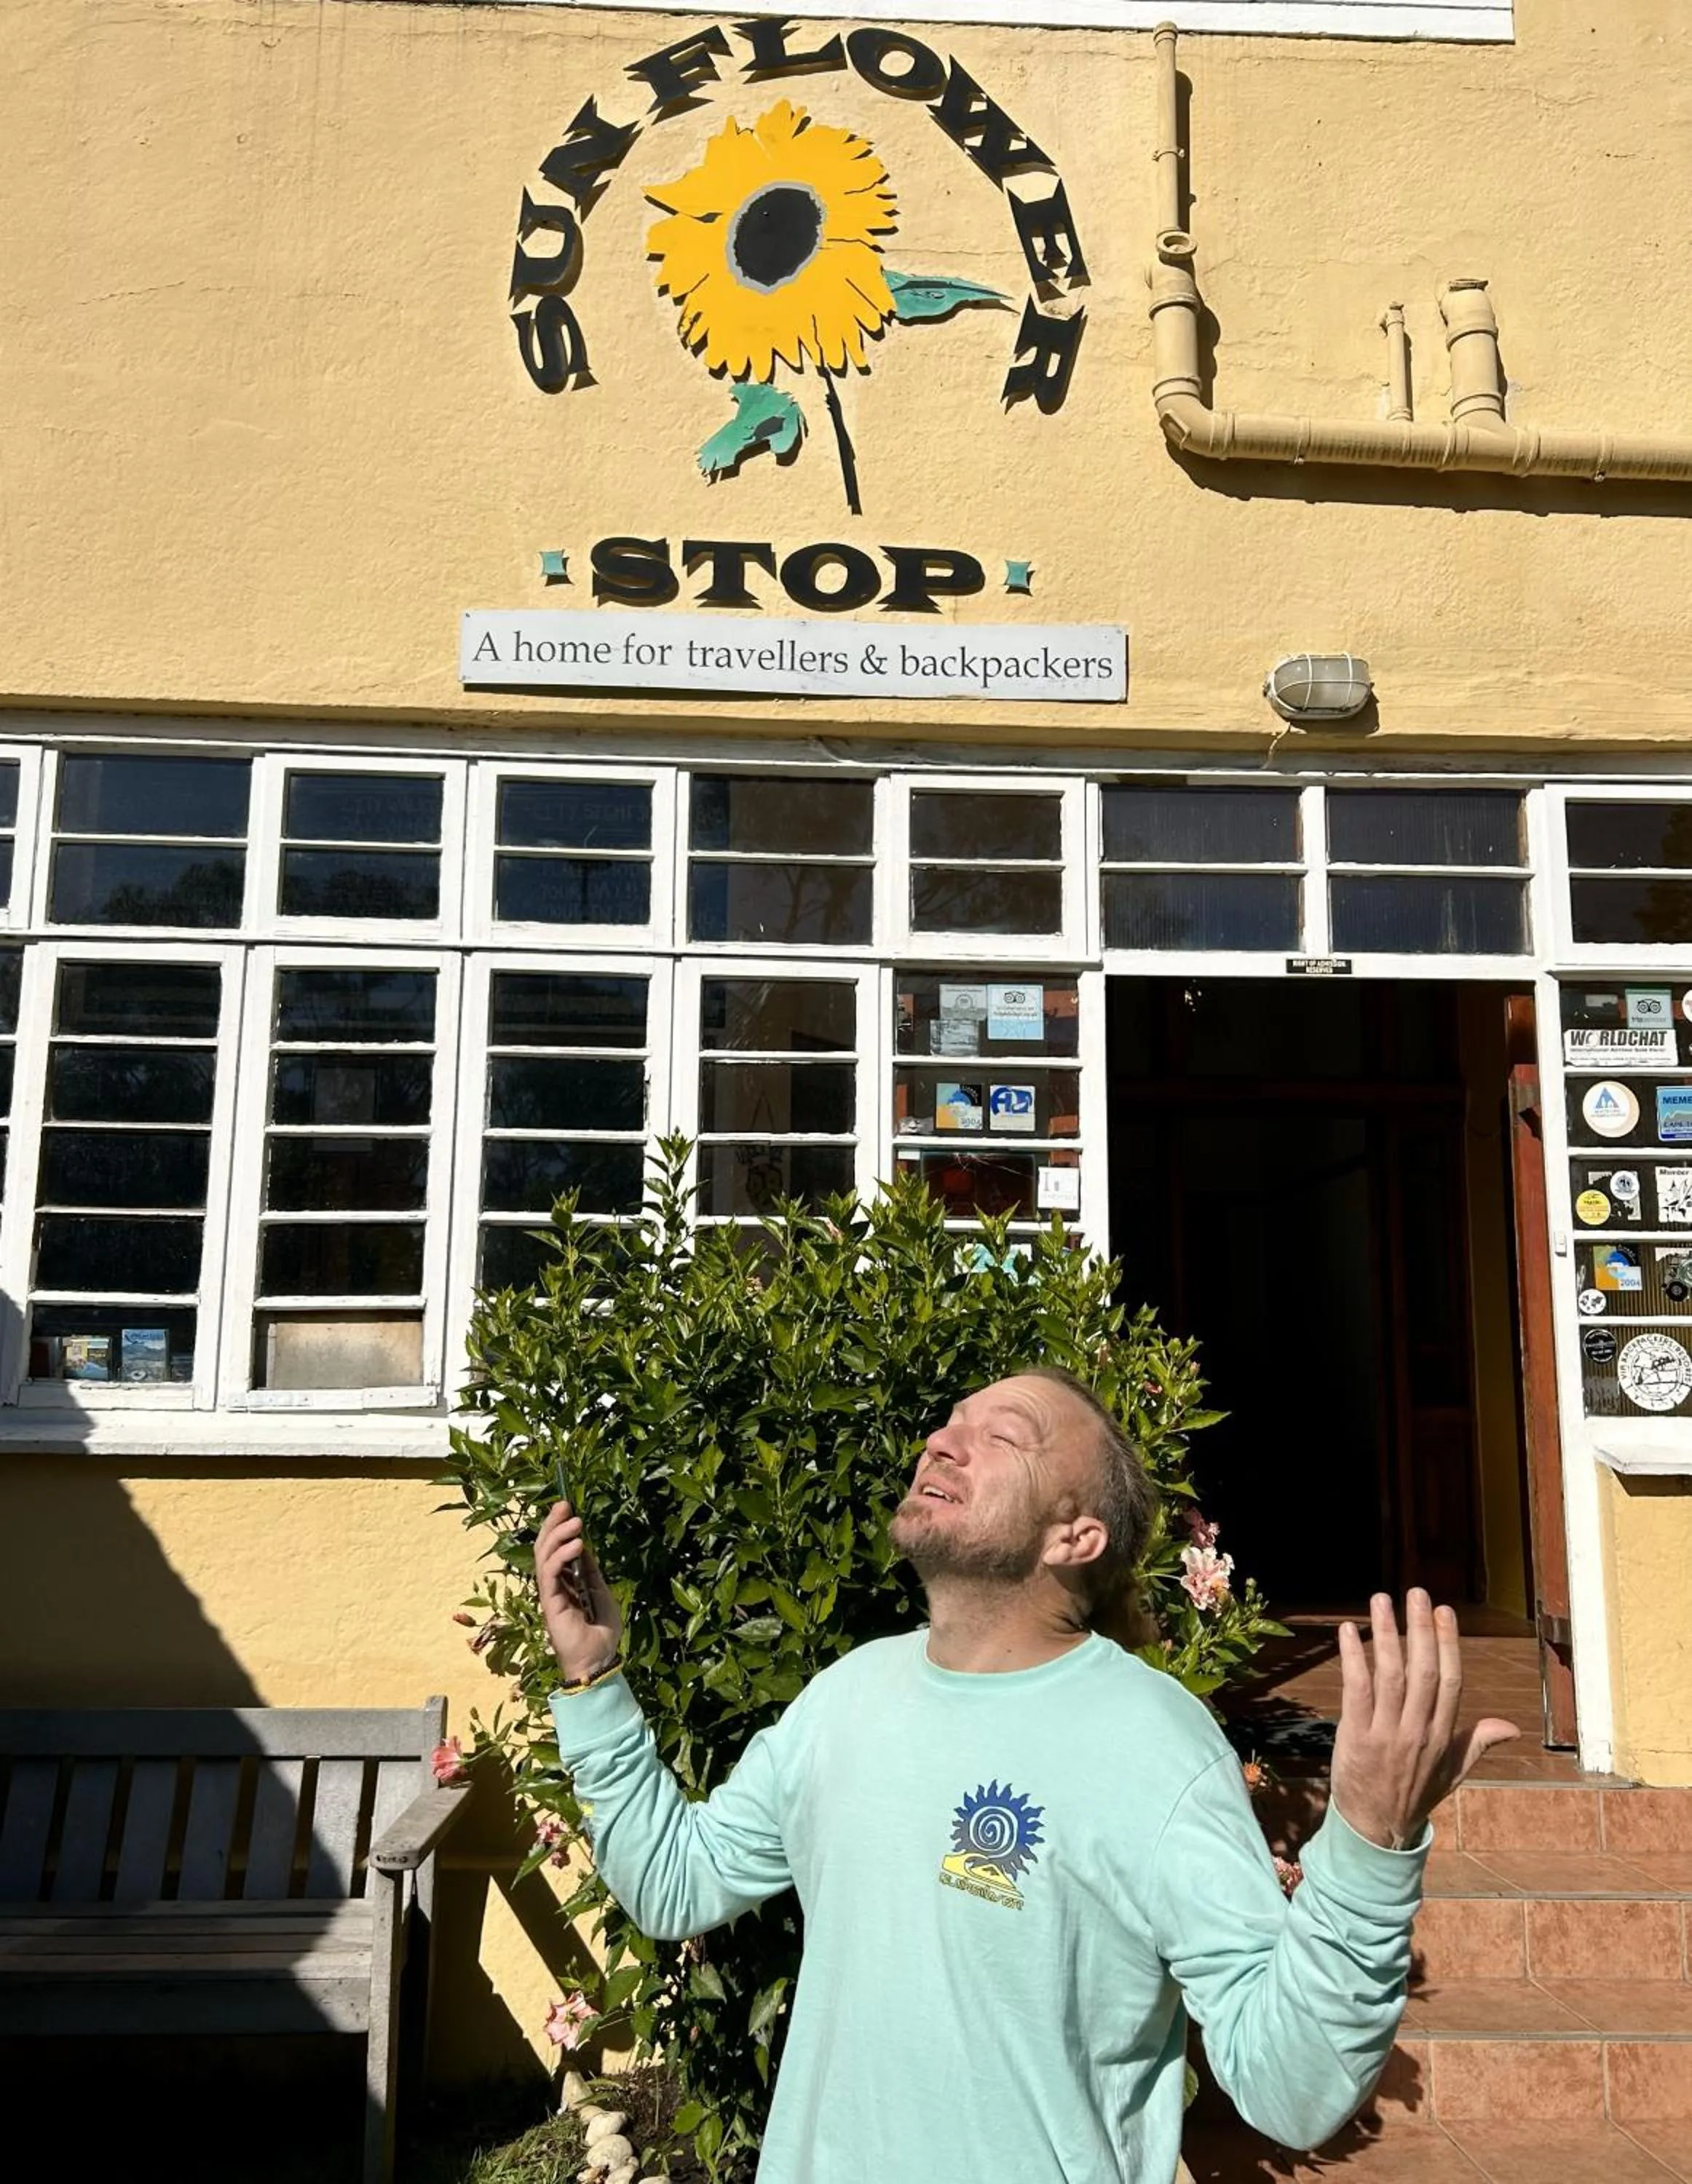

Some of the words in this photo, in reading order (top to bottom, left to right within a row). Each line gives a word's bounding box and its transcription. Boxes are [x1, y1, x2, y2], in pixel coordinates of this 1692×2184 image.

[508, 17, 1091, 415] SUNFLOWER
[590, 537, 986, 614] STOP
[472, 631, 502, 662] A
[512, 630, 612, 664] home
[621, 633, 673, 665] for
[687, 639, 849, 673] travellers
[859, 644, 889, 676] &
[900, 644, 1113, 689] backpackers
